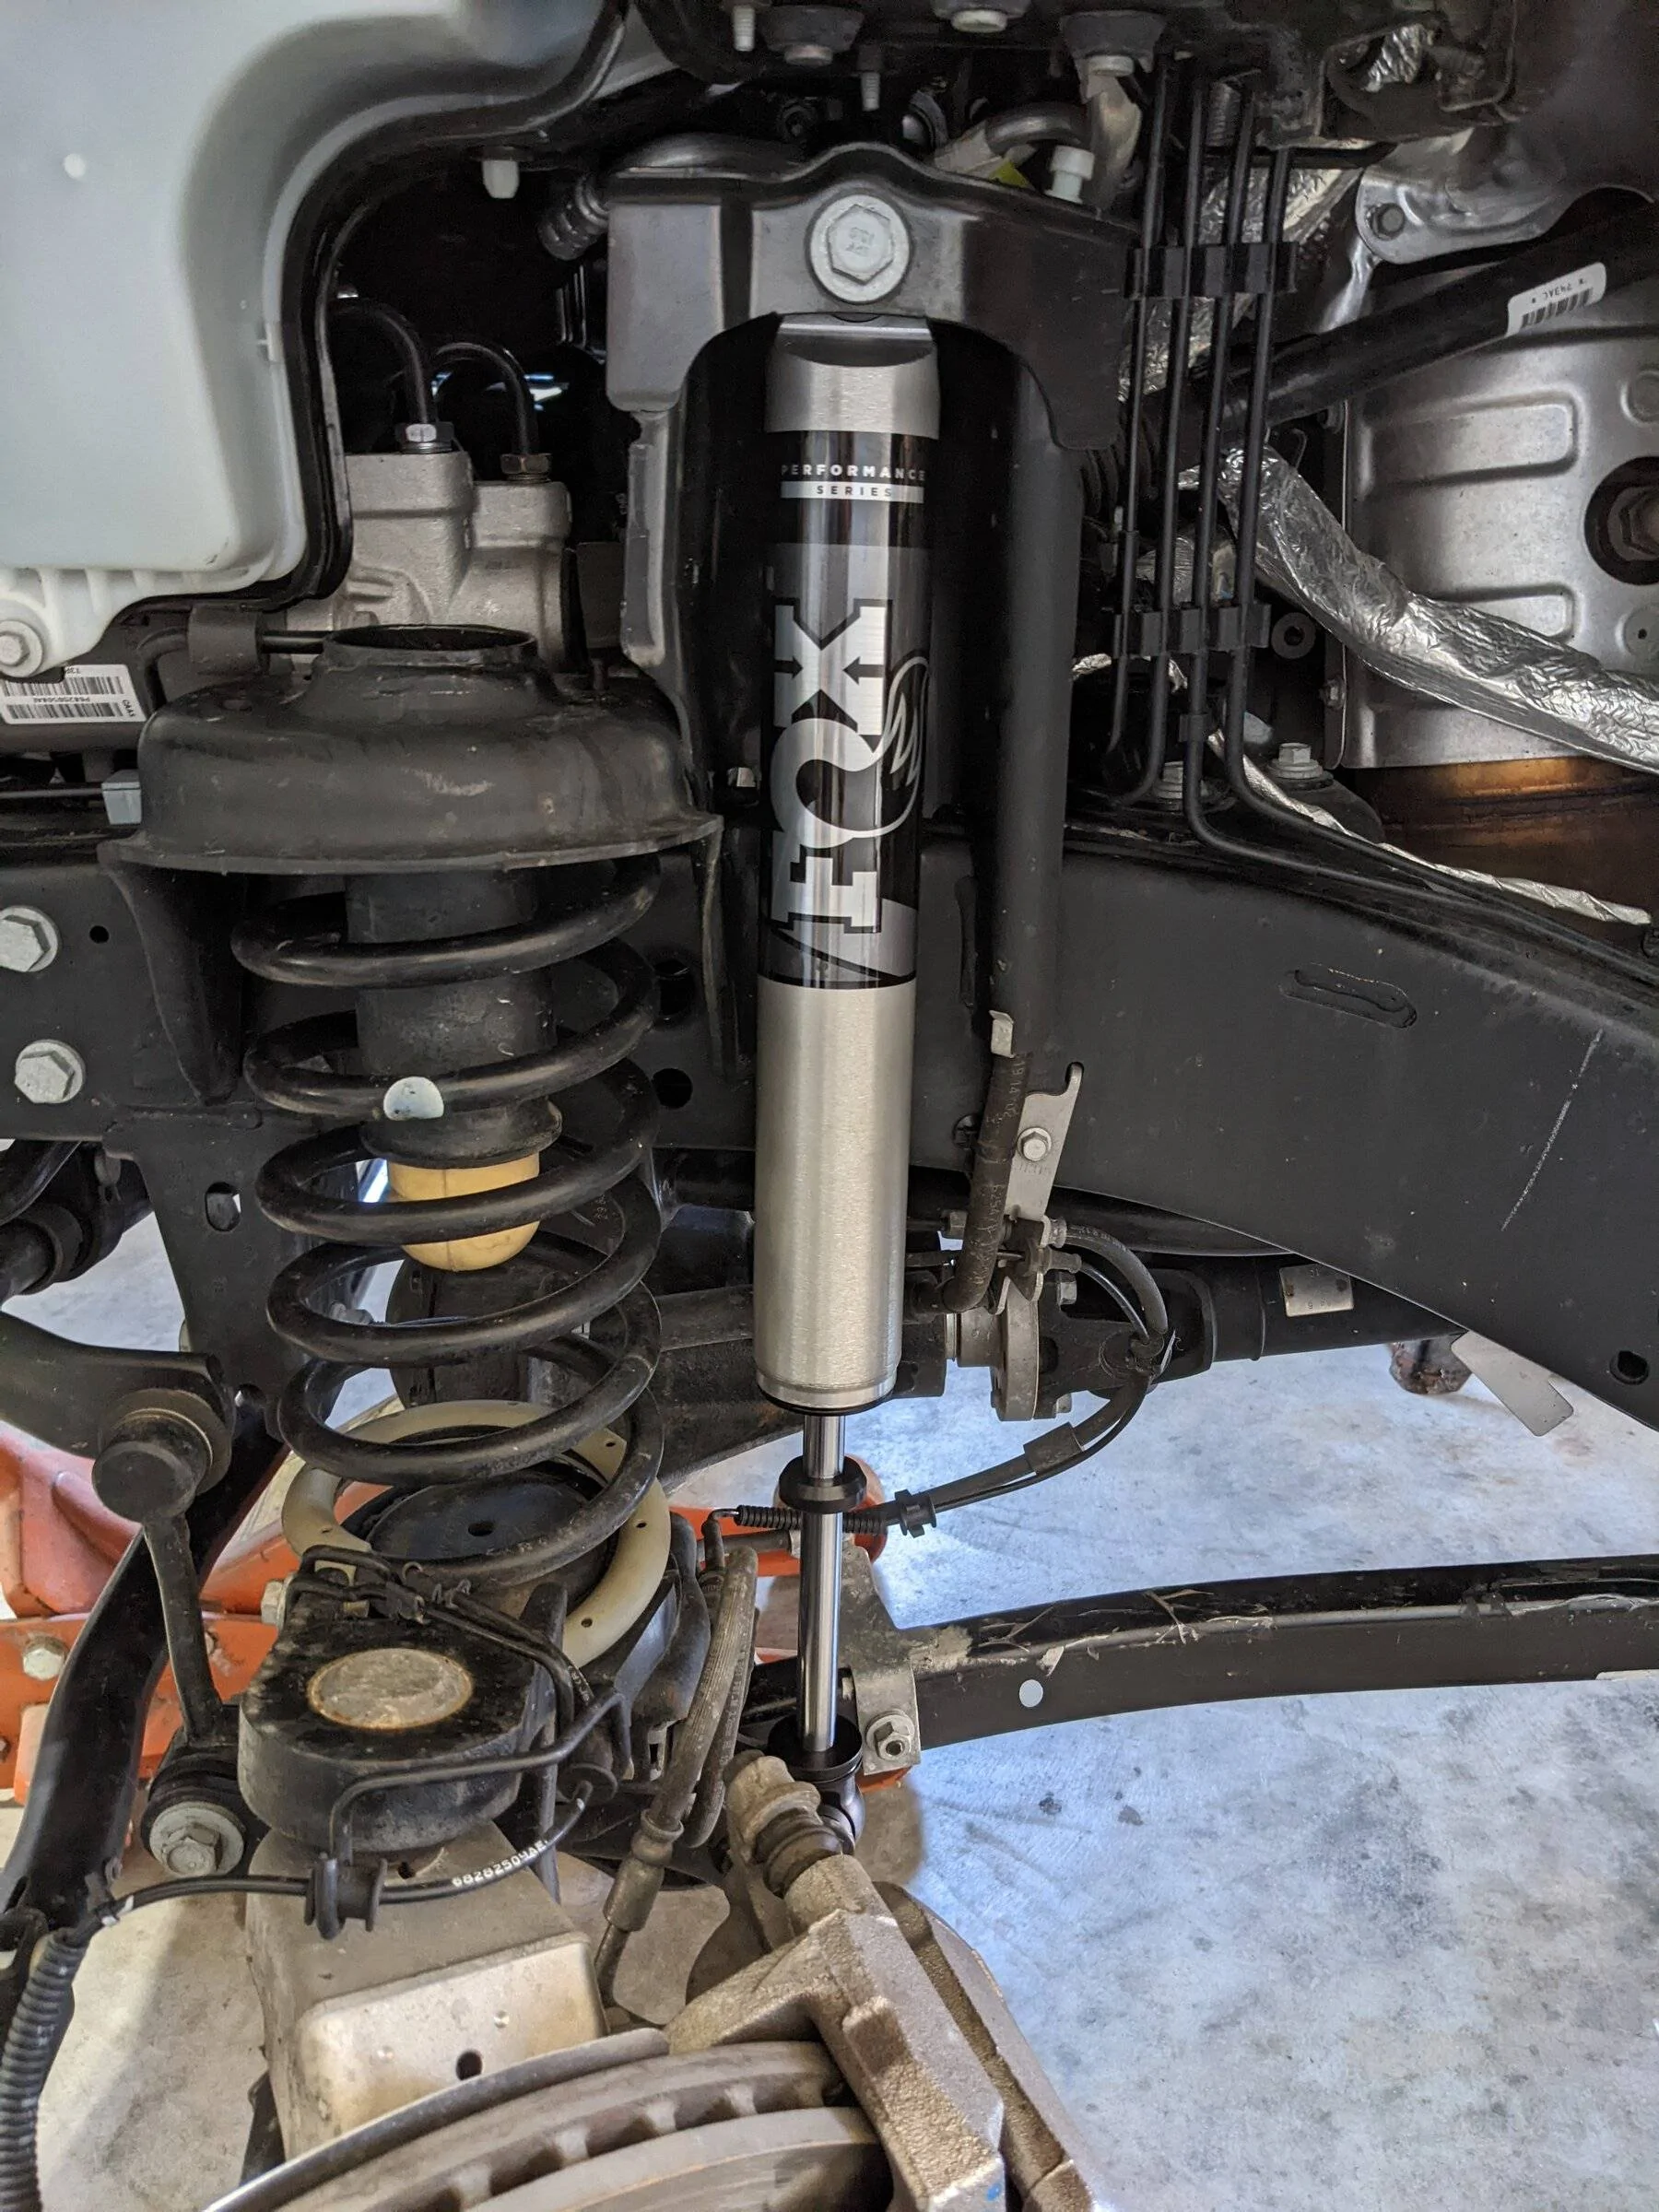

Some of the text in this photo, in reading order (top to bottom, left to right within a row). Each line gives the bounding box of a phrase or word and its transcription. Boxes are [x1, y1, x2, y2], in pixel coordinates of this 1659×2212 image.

[781, 464, 925, 481] PERFORMANCE
[816, 485, 892, 497] SERIES
[771, 604, 927, 929] FOX
